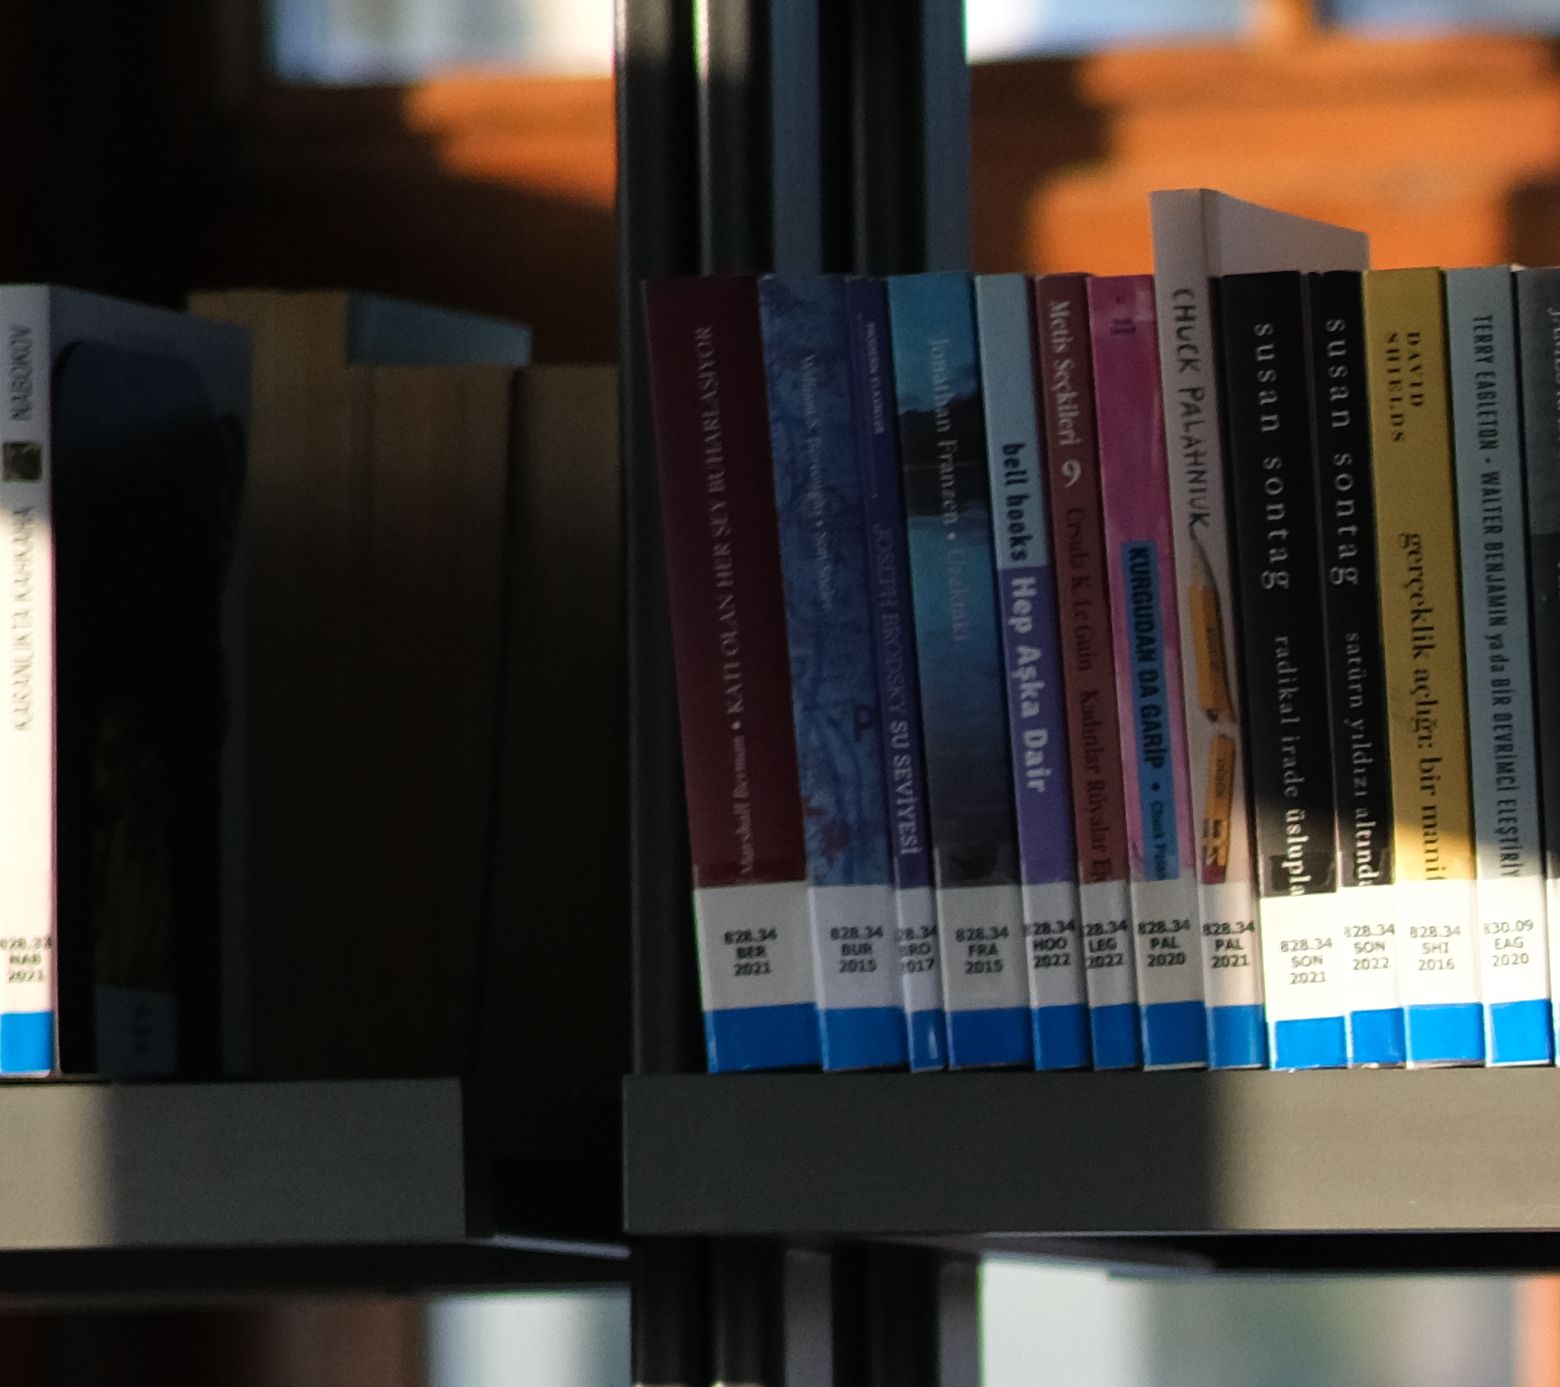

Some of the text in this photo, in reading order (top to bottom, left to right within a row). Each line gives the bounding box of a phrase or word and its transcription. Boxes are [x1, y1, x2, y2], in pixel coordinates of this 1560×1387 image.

[1002, 442, 1031, 561] bell hooks
[1171, 288, 1211, 530] CHUCK PALAHNIUK
[1324, 319, 1363, 587] susan sontag
[1006, 575, 1052, 793] Hep Aşka Dair
[1127, 545, 1167, 769] KURGUDAN DA GARİP
